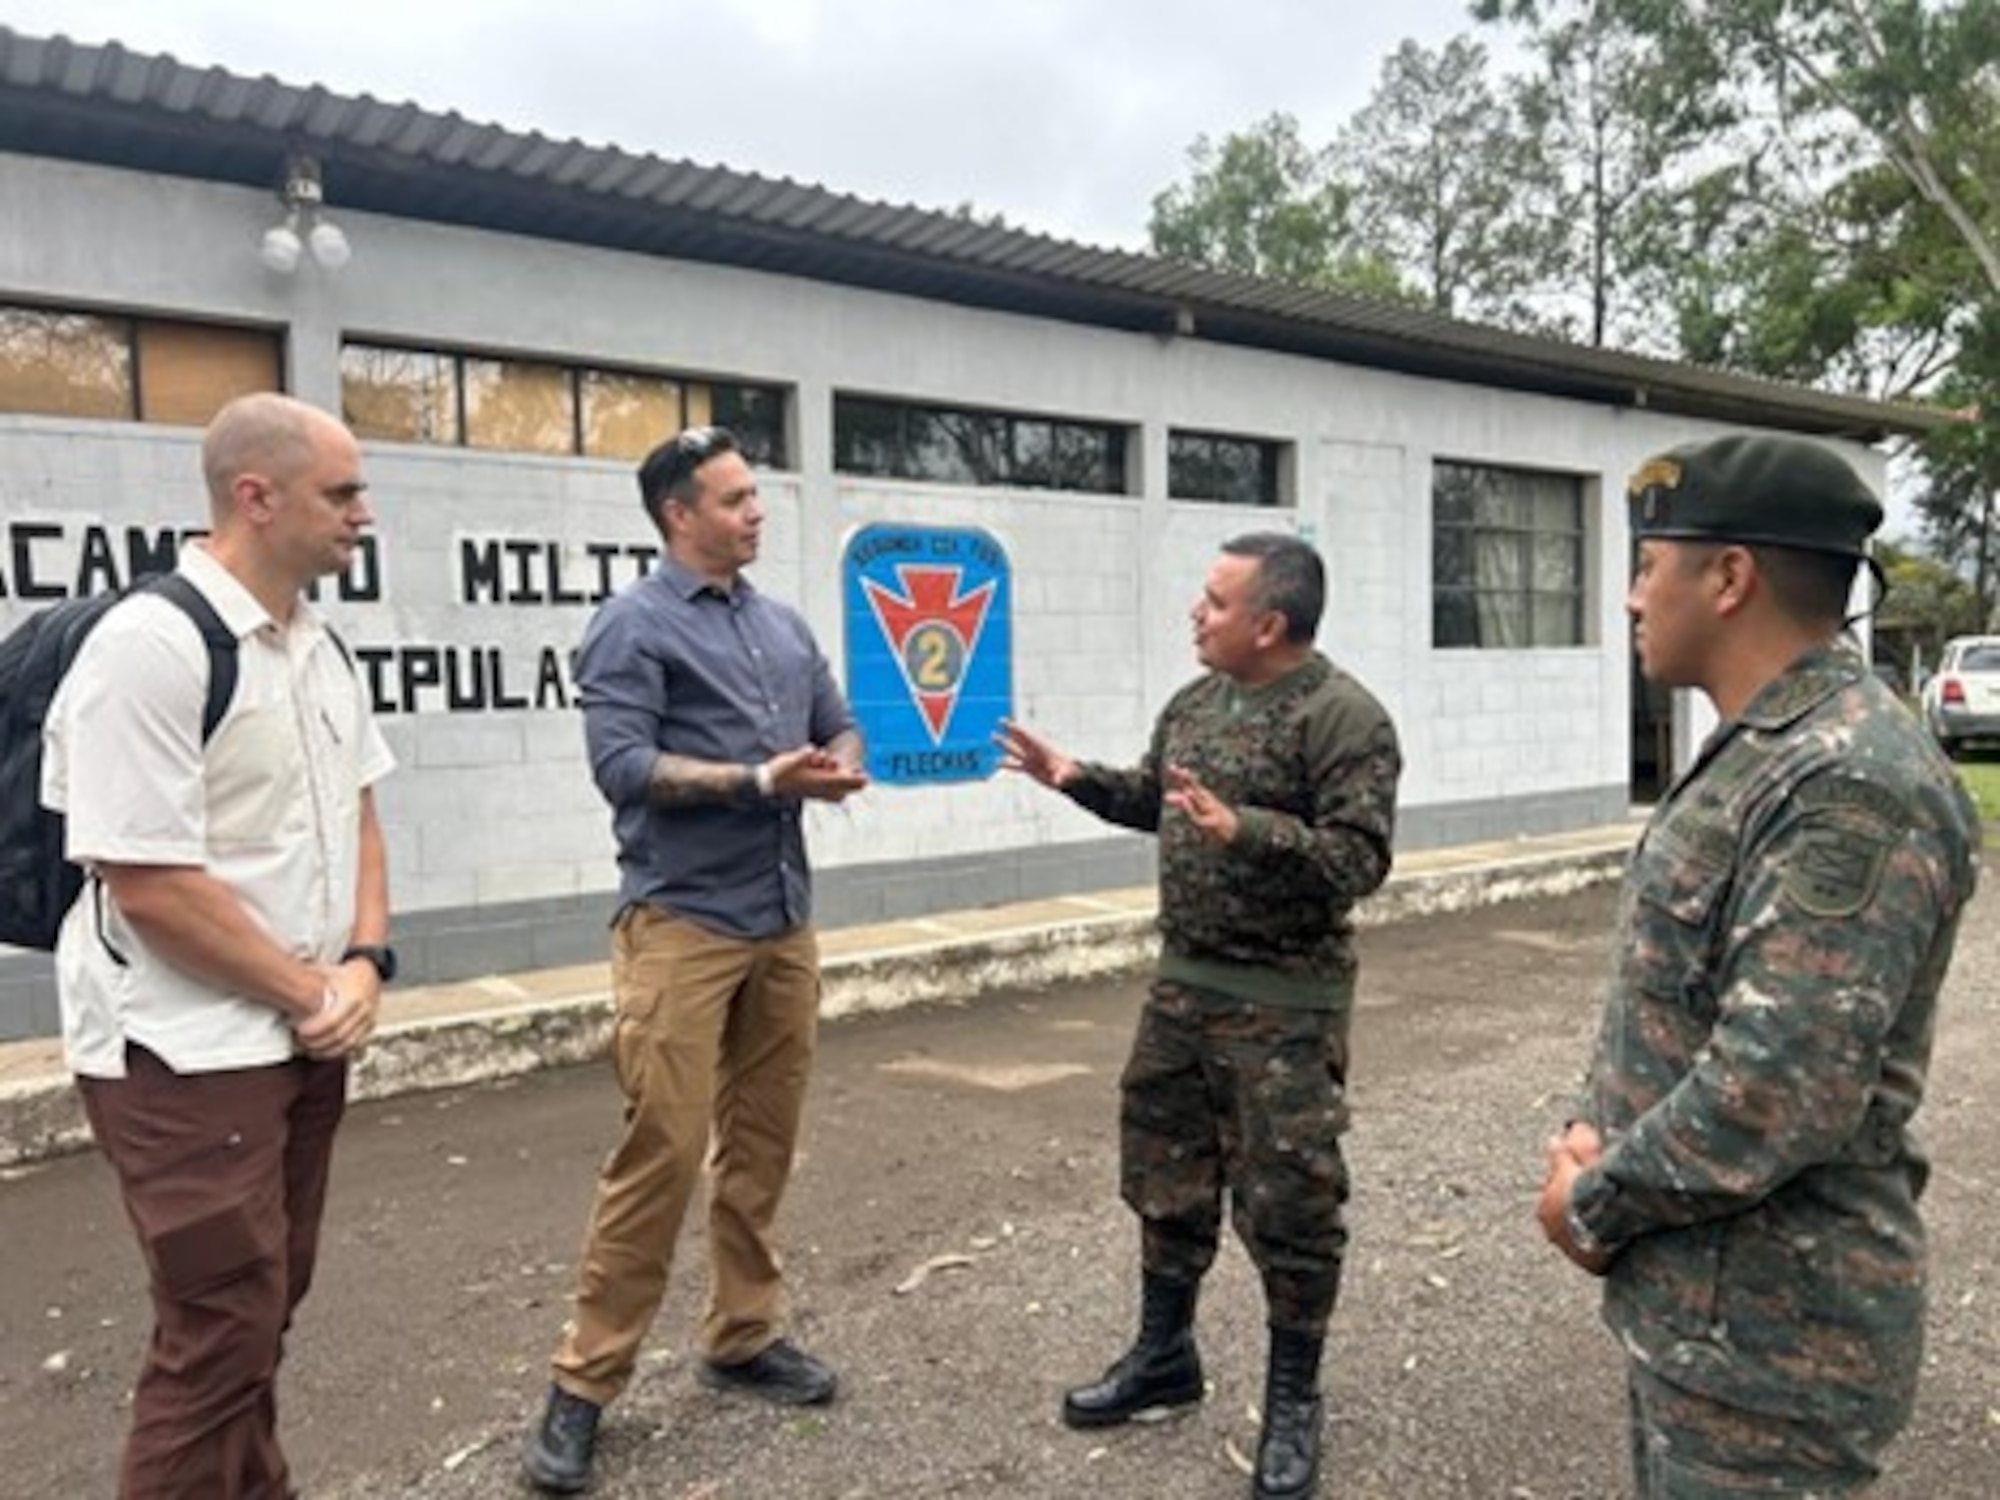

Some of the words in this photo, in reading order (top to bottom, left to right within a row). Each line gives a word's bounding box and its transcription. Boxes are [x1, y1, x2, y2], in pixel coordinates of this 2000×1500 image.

[461, 538, 659, 605] MILIT
[355, 646, 586, 714] IPULA
[917, 630, 949, 687] 2
